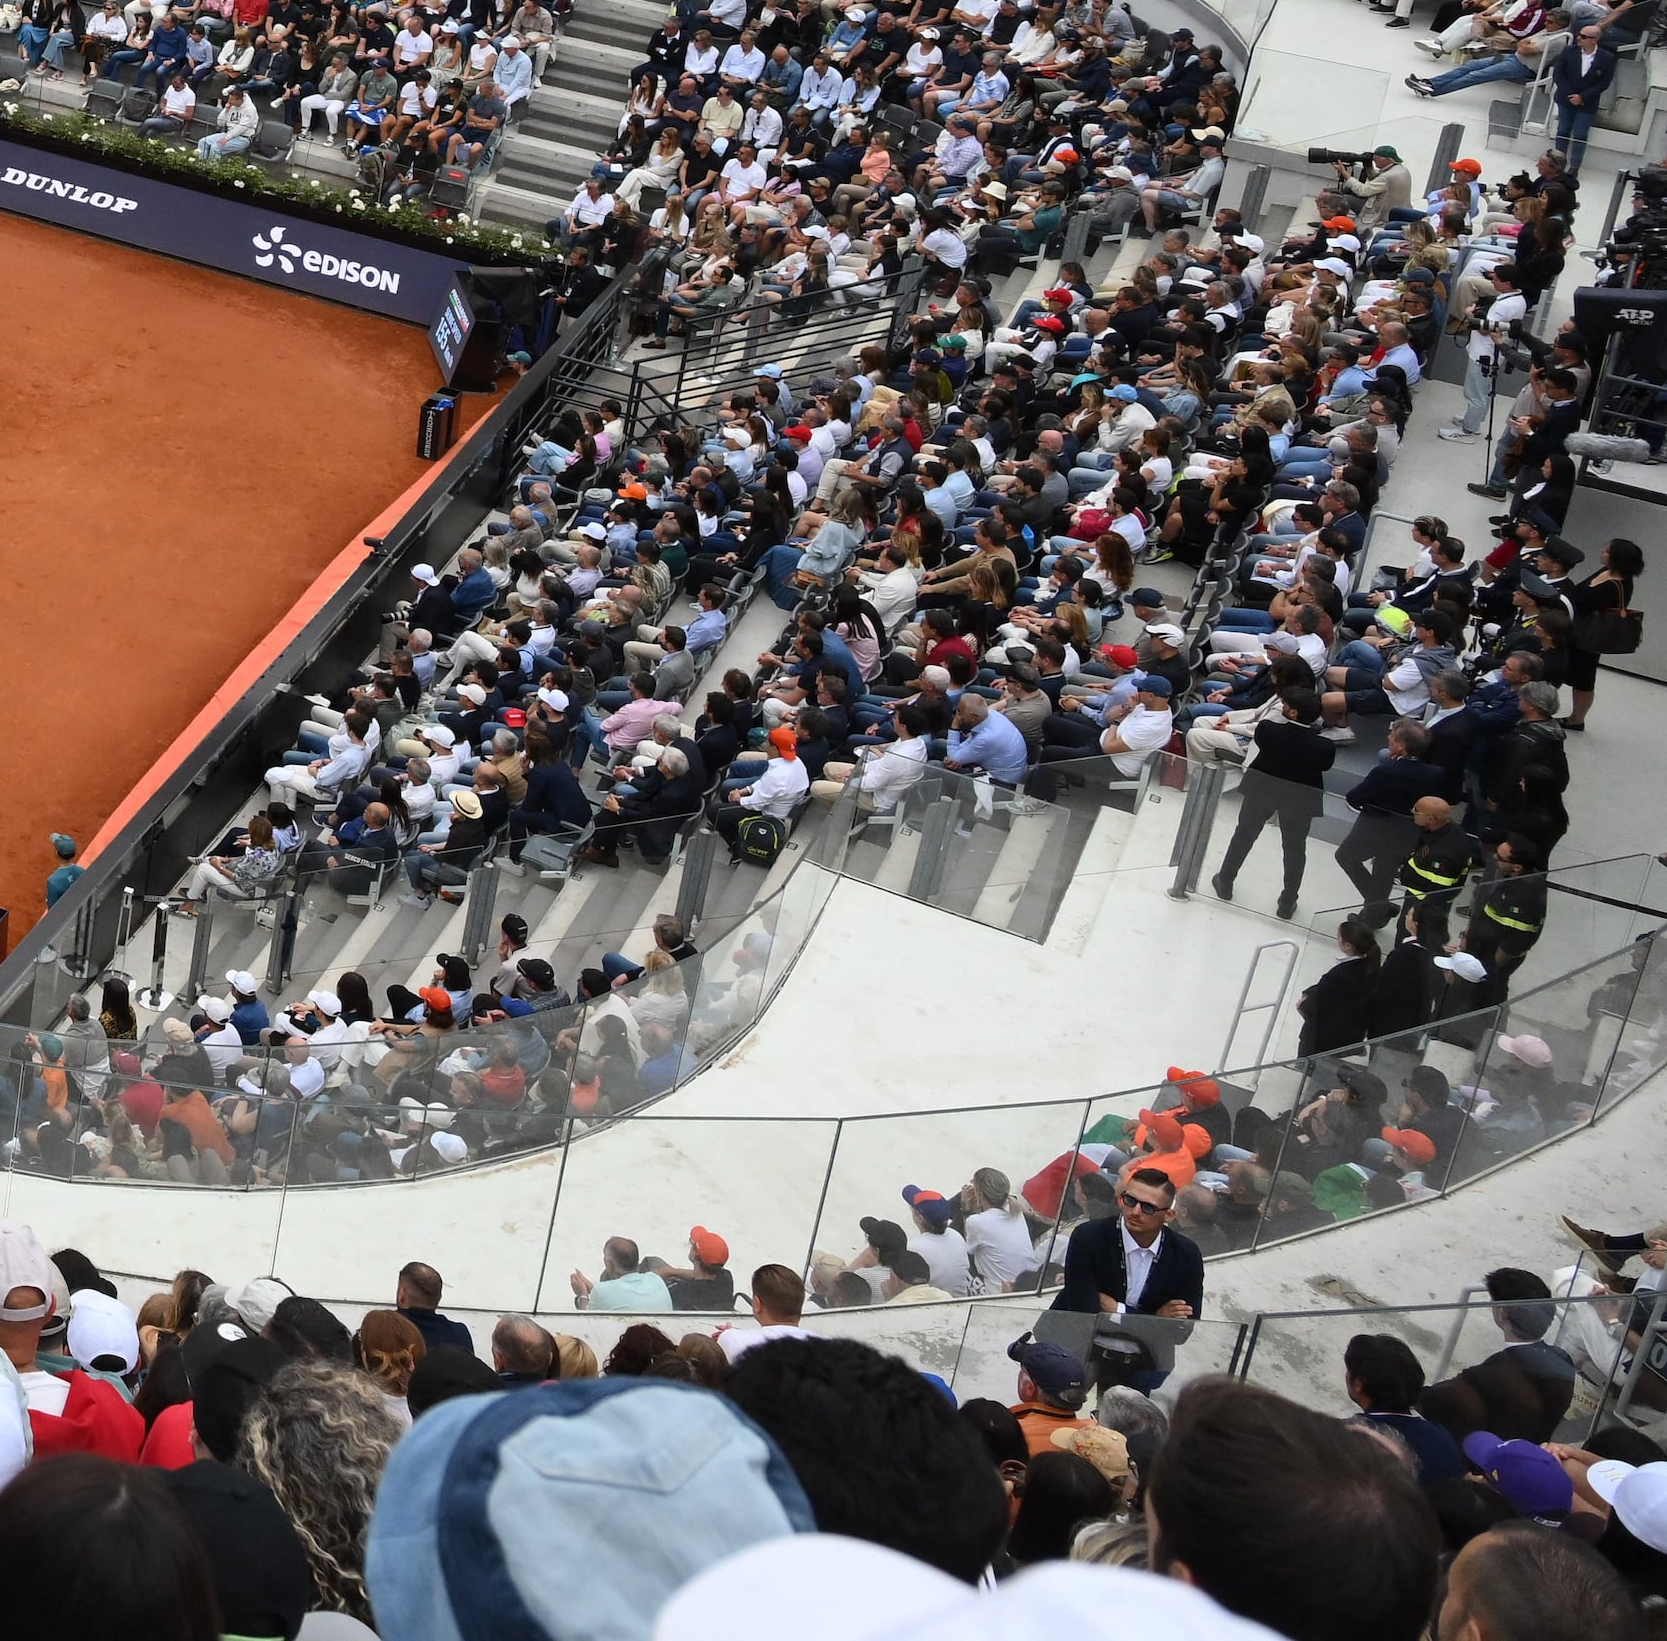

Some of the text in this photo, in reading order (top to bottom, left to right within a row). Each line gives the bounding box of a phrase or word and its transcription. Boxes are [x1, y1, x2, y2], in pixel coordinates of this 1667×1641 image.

[0, 166, 138, 215] DUNLOP
[1612, 308, 1655, 320] ATP
[424, 418, 434, 459] AURICCHIO
